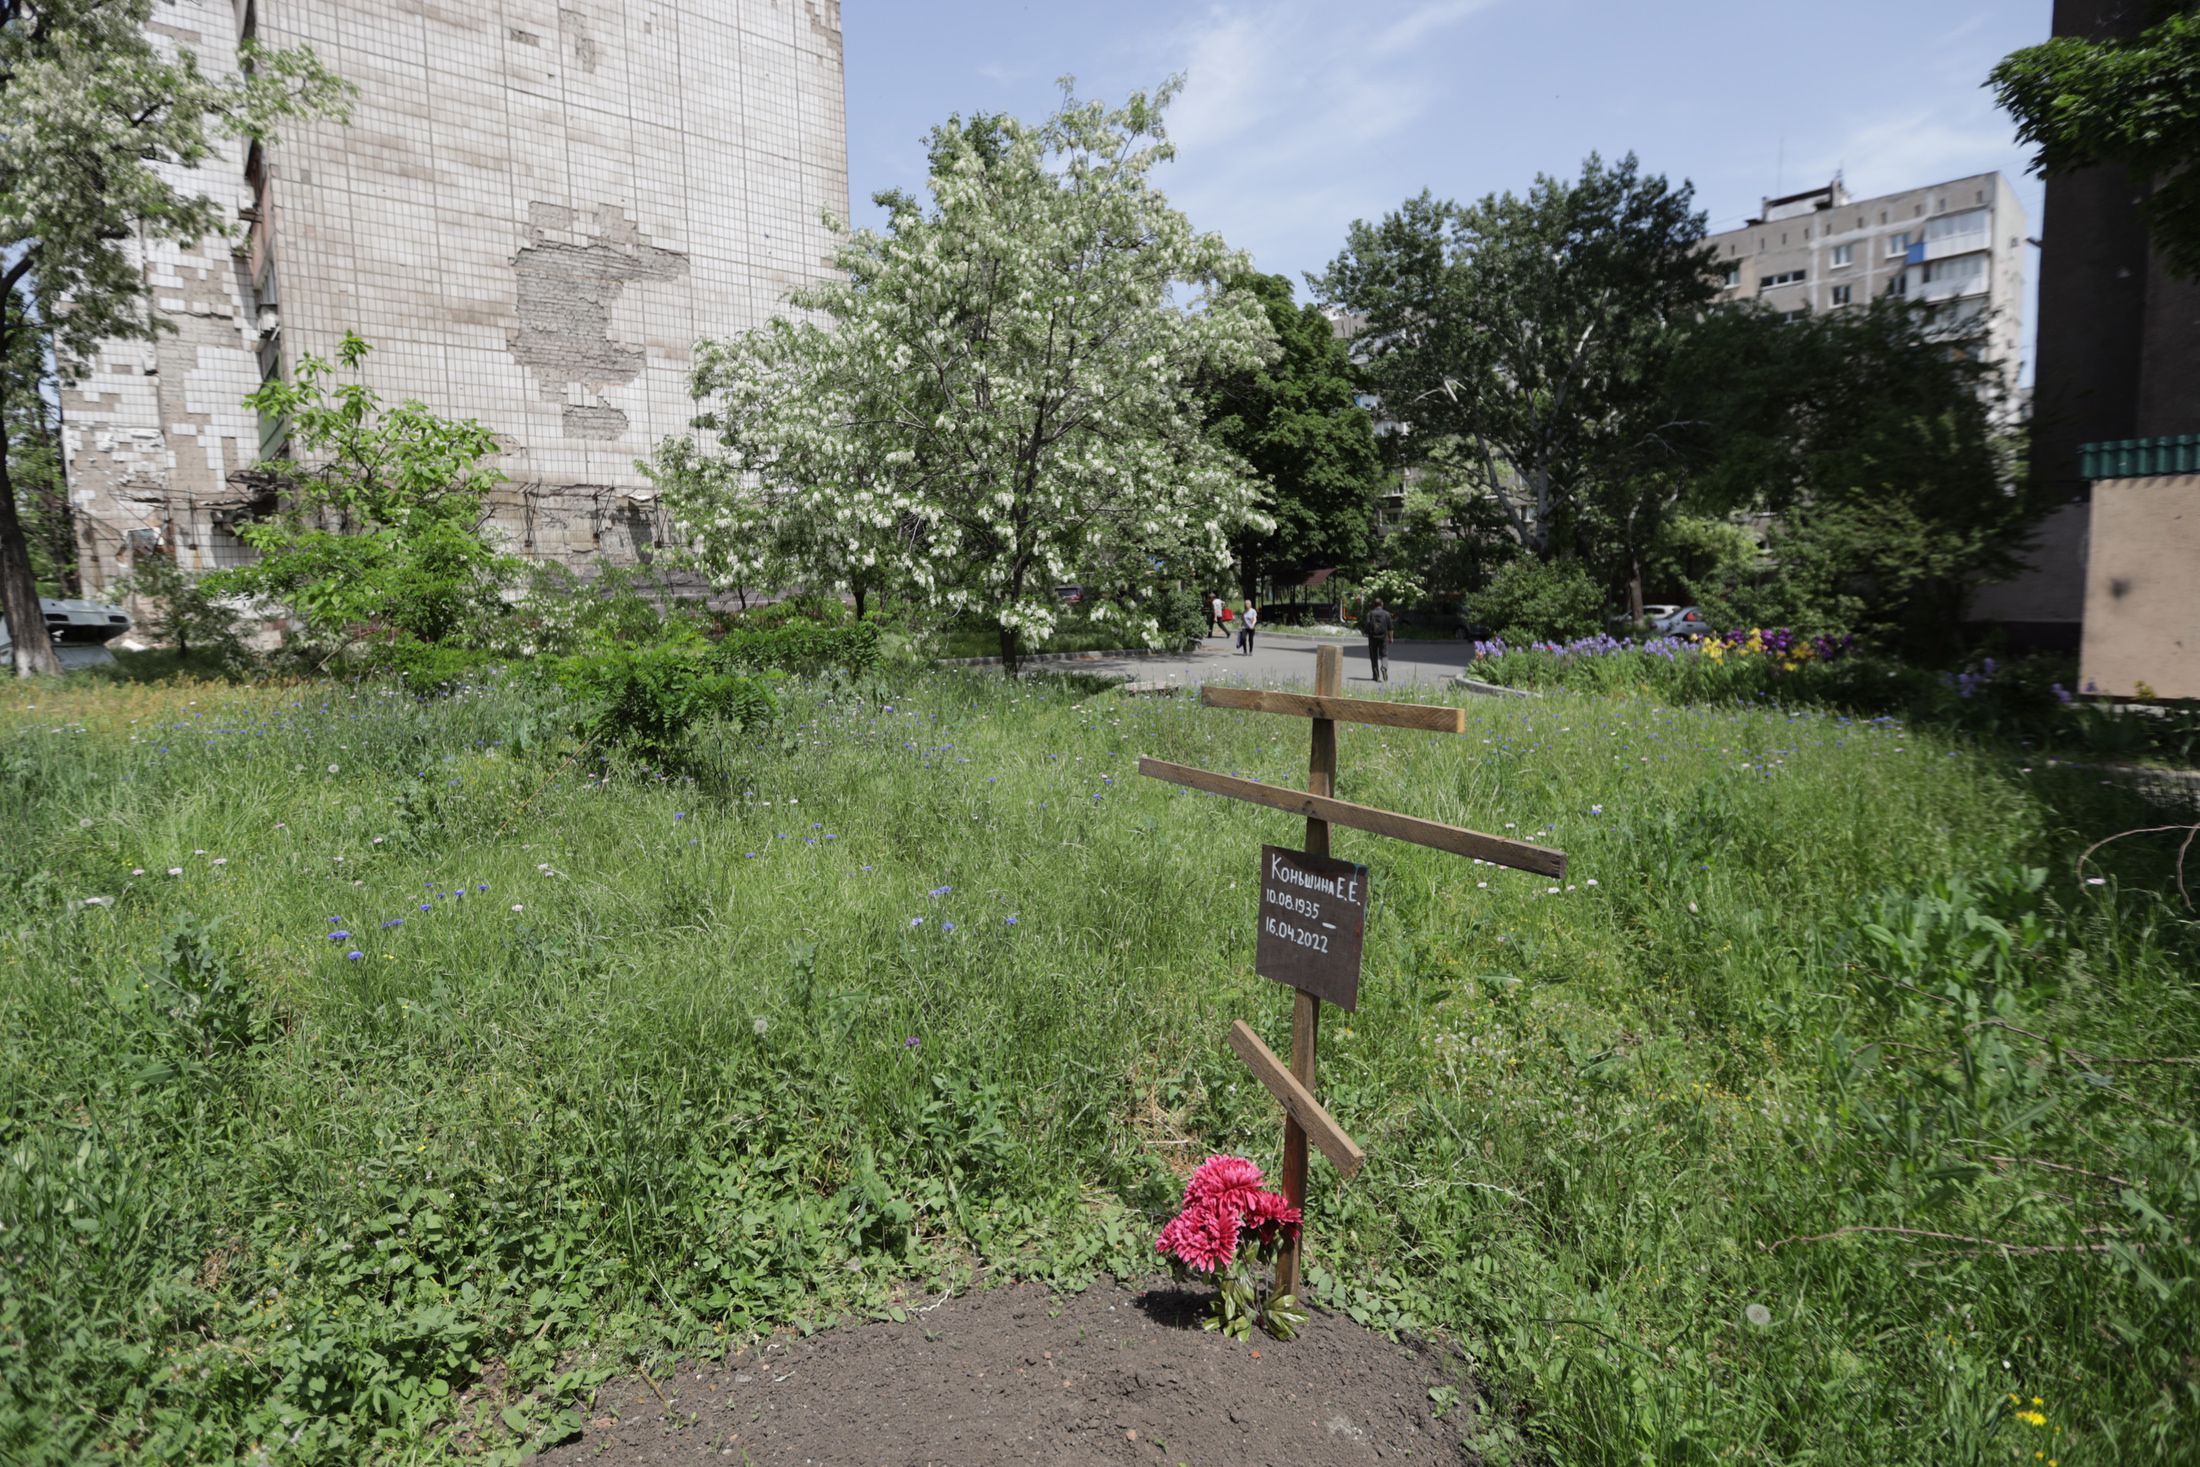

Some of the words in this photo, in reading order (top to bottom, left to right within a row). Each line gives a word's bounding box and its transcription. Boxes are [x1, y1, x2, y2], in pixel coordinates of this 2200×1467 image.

[1271, 853, 1335, 896] Коньшина
[1266, 888, 1320, 919] 10.08.1935
[1265, 916, 1329, 954] 16.04.2022
